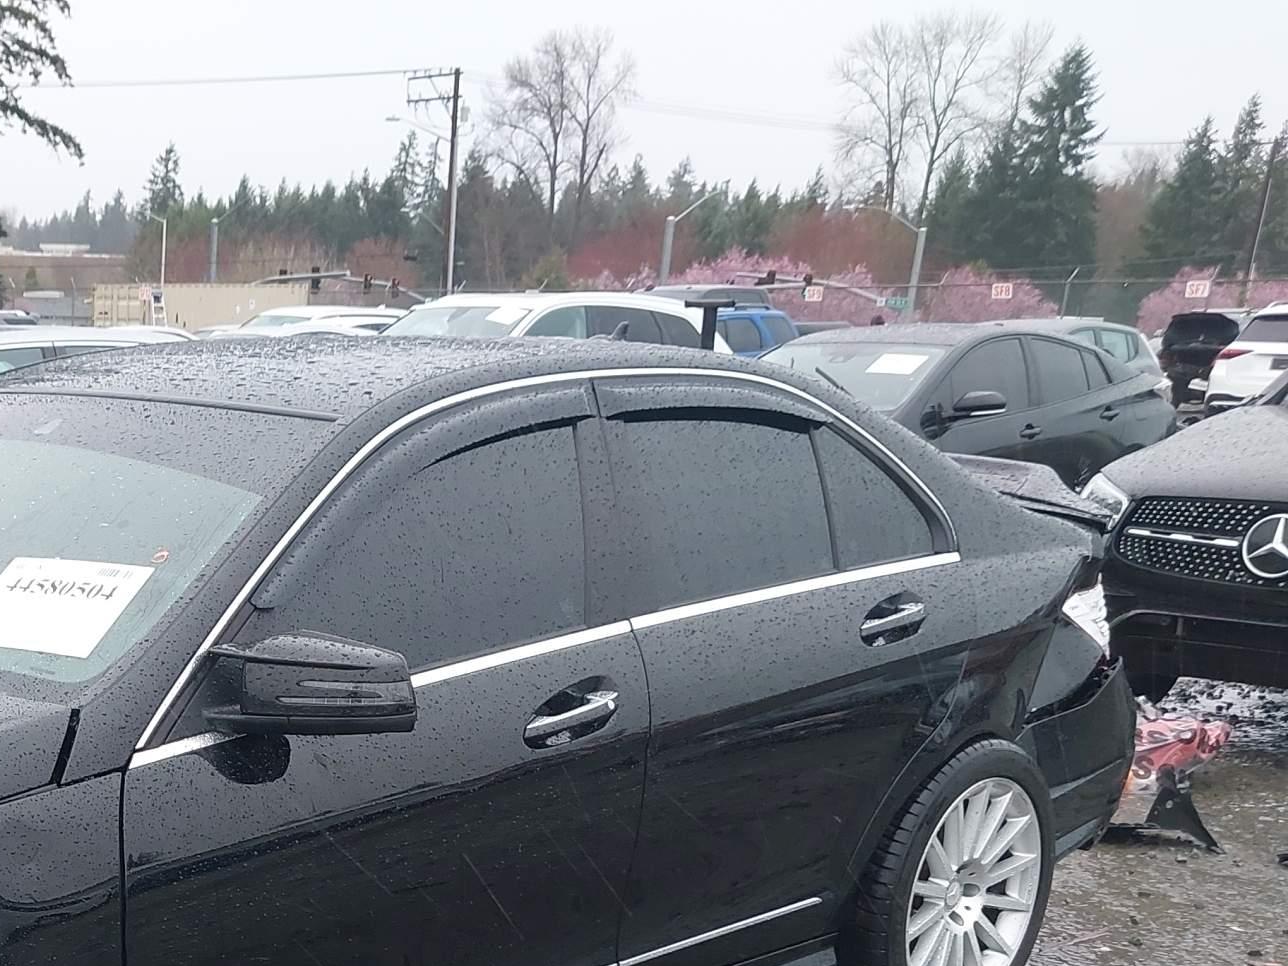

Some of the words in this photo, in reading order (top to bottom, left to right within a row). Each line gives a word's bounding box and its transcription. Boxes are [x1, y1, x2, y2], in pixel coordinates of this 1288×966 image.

[993, 284, 1011, 297] SF8
[1186, 282, 1208, 296] SF7
[6, 577, 118, 600] 44580504
